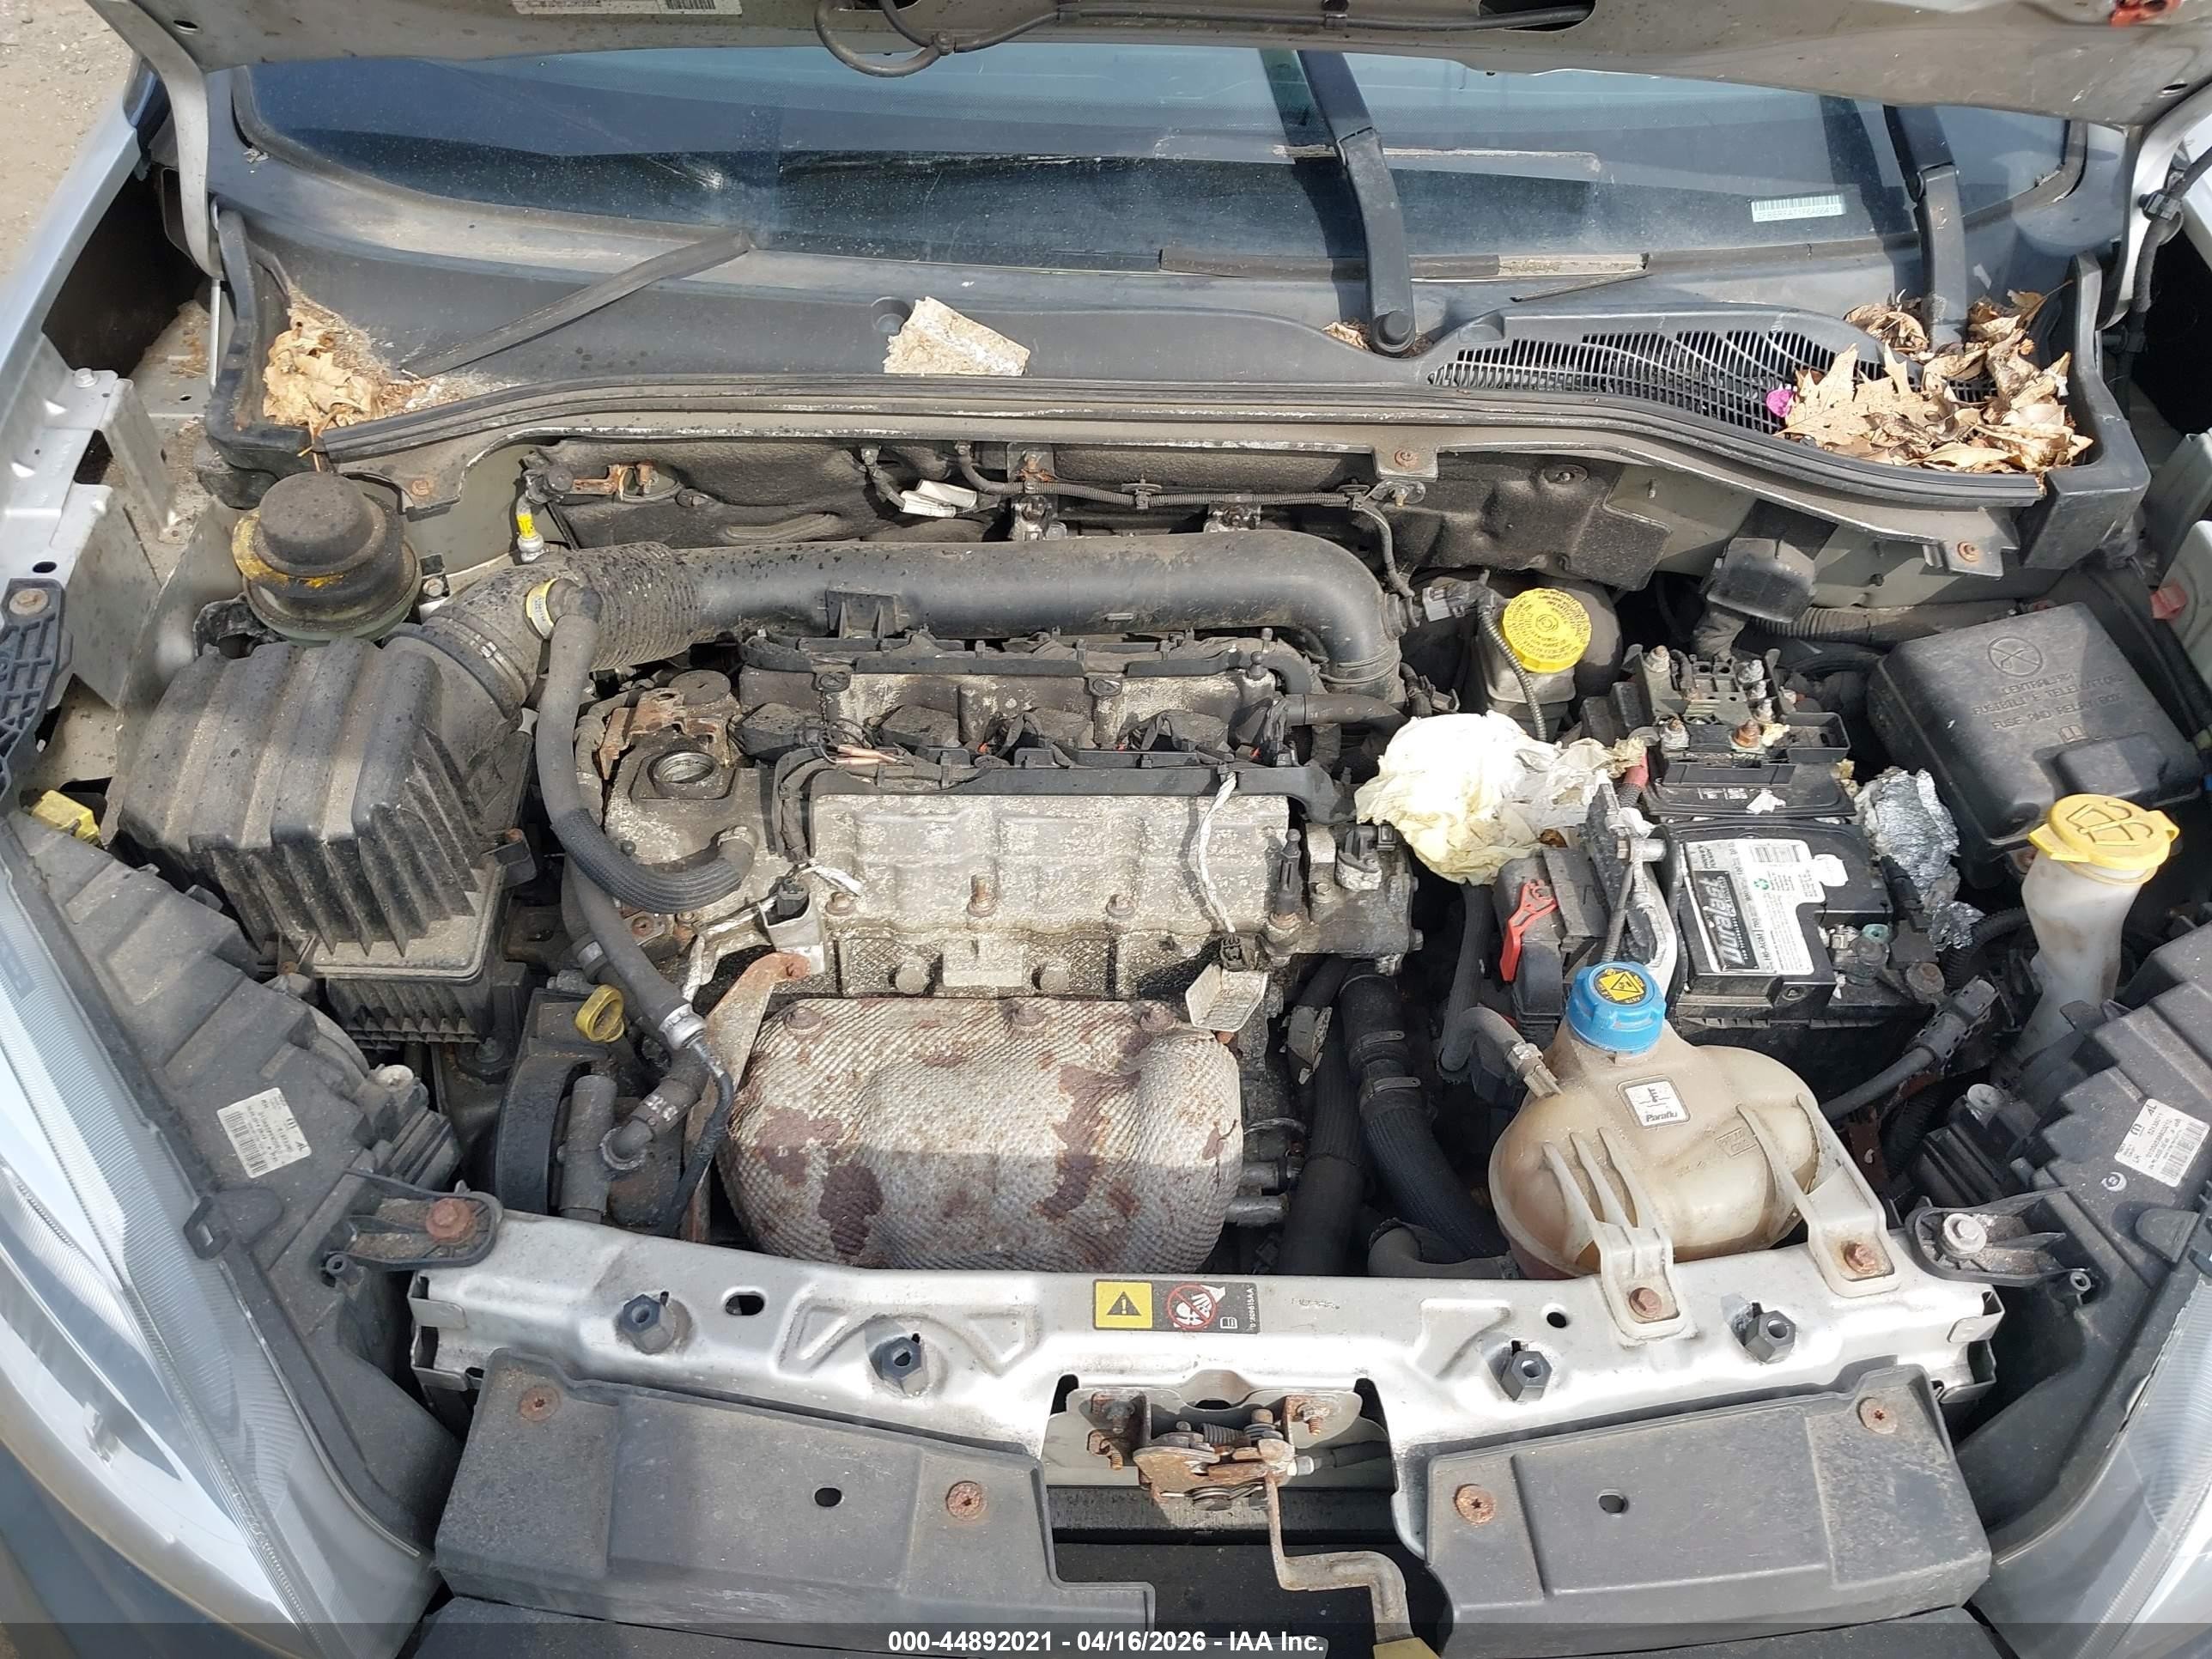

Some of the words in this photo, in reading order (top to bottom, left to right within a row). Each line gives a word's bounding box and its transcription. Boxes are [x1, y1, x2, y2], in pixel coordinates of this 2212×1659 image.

[1991, 715, 2023, 731] FUSE
[2027, 710, 2052, 723] AND
[2057, 700, 2094, 716] RELAY
[2096, 693, 2124, 706] BOX
[1698, 874, 1746, 966] Duralast
[1645, 1110, 1679, 1122] Paraflu
